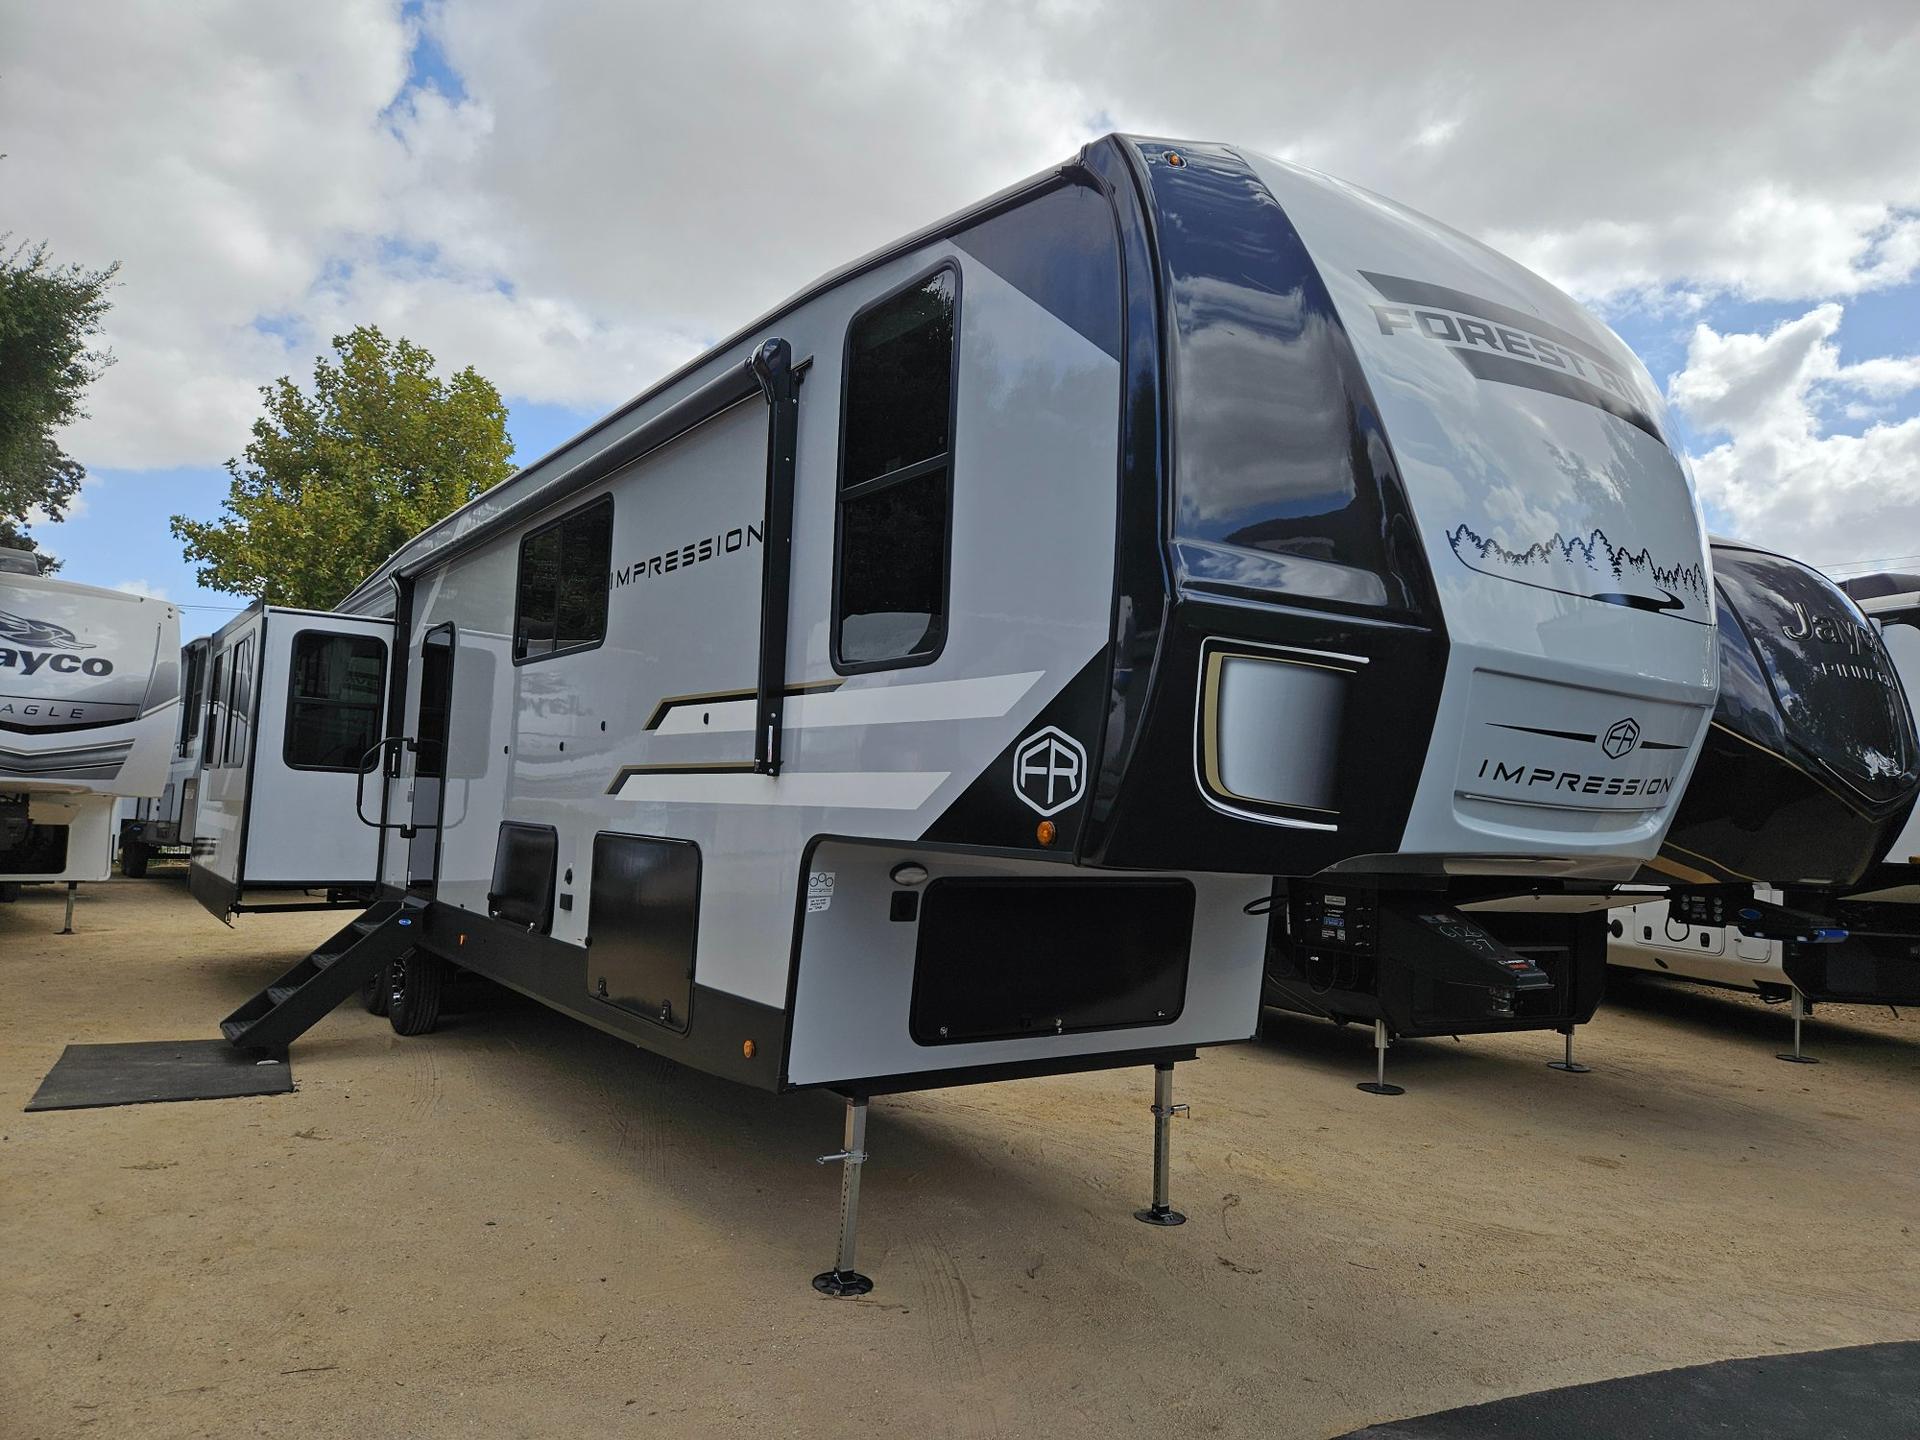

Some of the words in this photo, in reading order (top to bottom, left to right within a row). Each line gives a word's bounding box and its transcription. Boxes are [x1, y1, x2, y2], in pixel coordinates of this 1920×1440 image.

[1368, 304, 1585, 377] FOREST
[609, 519, 764, 590] IMPRESSION
[1478, 759, 1675, 796] IMPRESSION
